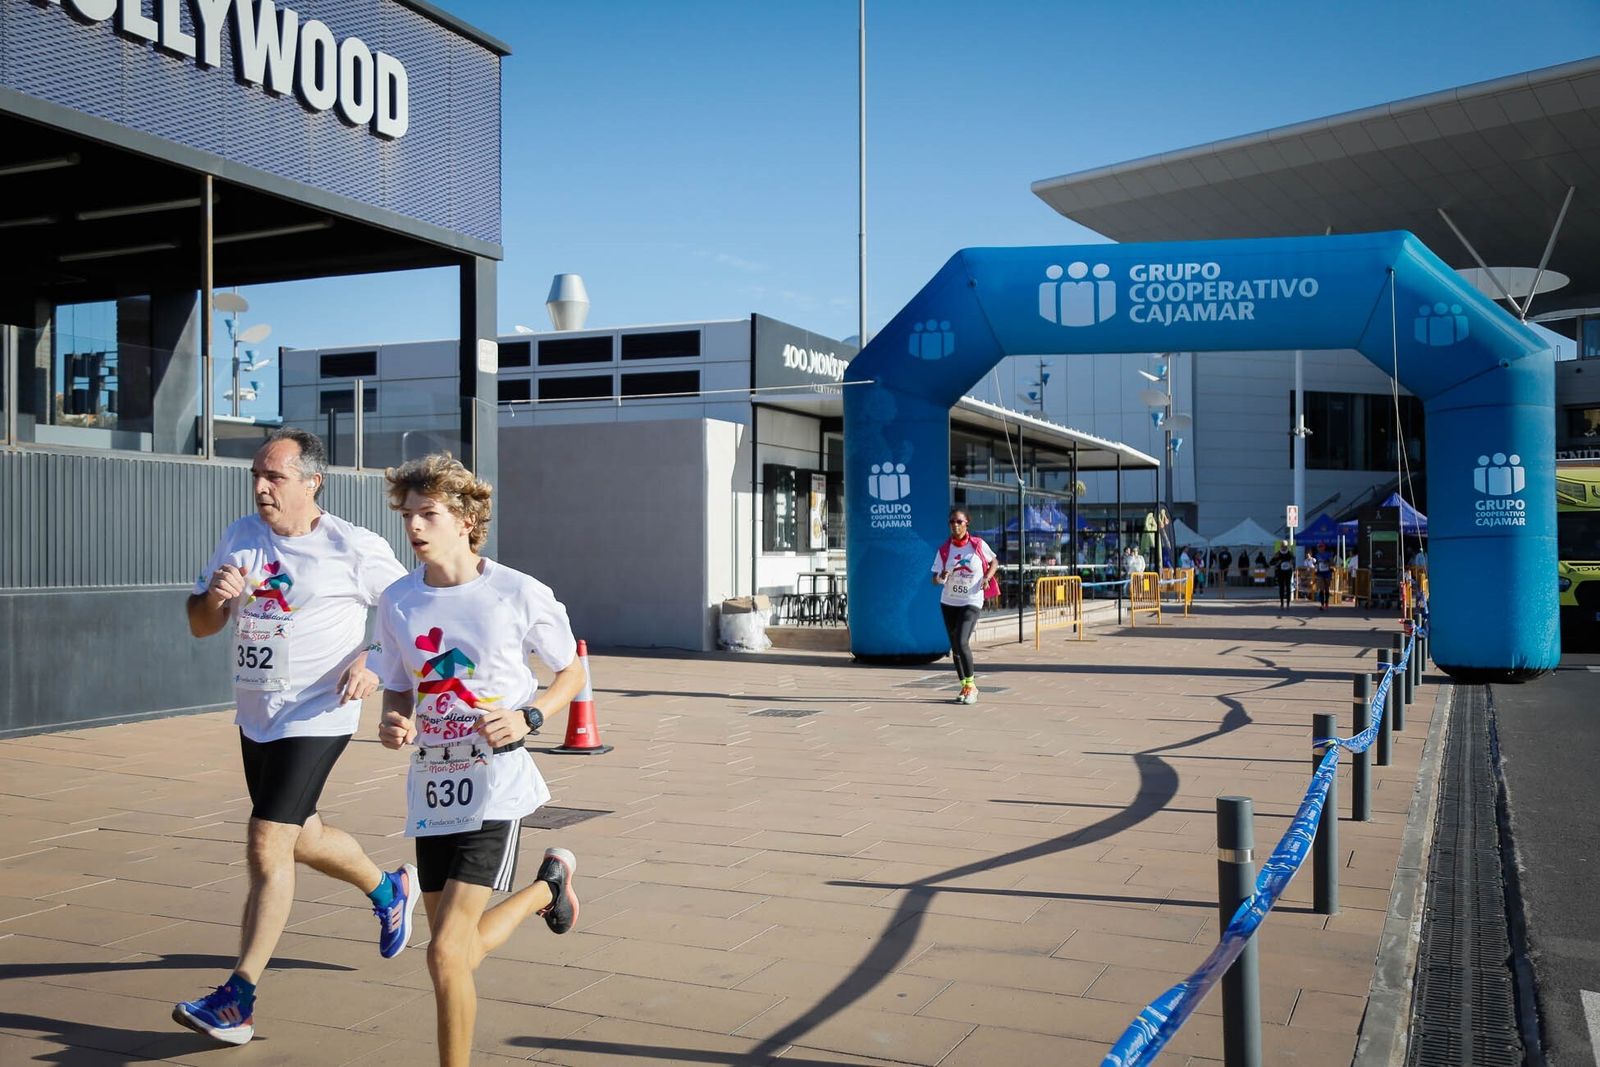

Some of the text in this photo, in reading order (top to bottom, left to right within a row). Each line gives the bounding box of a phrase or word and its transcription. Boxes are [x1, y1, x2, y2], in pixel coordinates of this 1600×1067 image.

[48, 0, 409, 140] LLYWOOD
[1129, 262, 1221, 282] GRUPO
[1129, 277, 1319, 303] COOPERATIVO
[1129, 302, 1255, 326] CAJAMAR
[782, 344, 808, 371] 100
[870, 504, 912, 514] GRUPO
[1475, 499, 1526, 511] GRUPO
[871, 520, 912, 529] CAJAMAR
[1475, 517, 1526, 528] CAJAMAR
[237, 644, 274, 670] 352
[448, 762, 471, 774] Stop
[426, 777, 474, 809] 630
